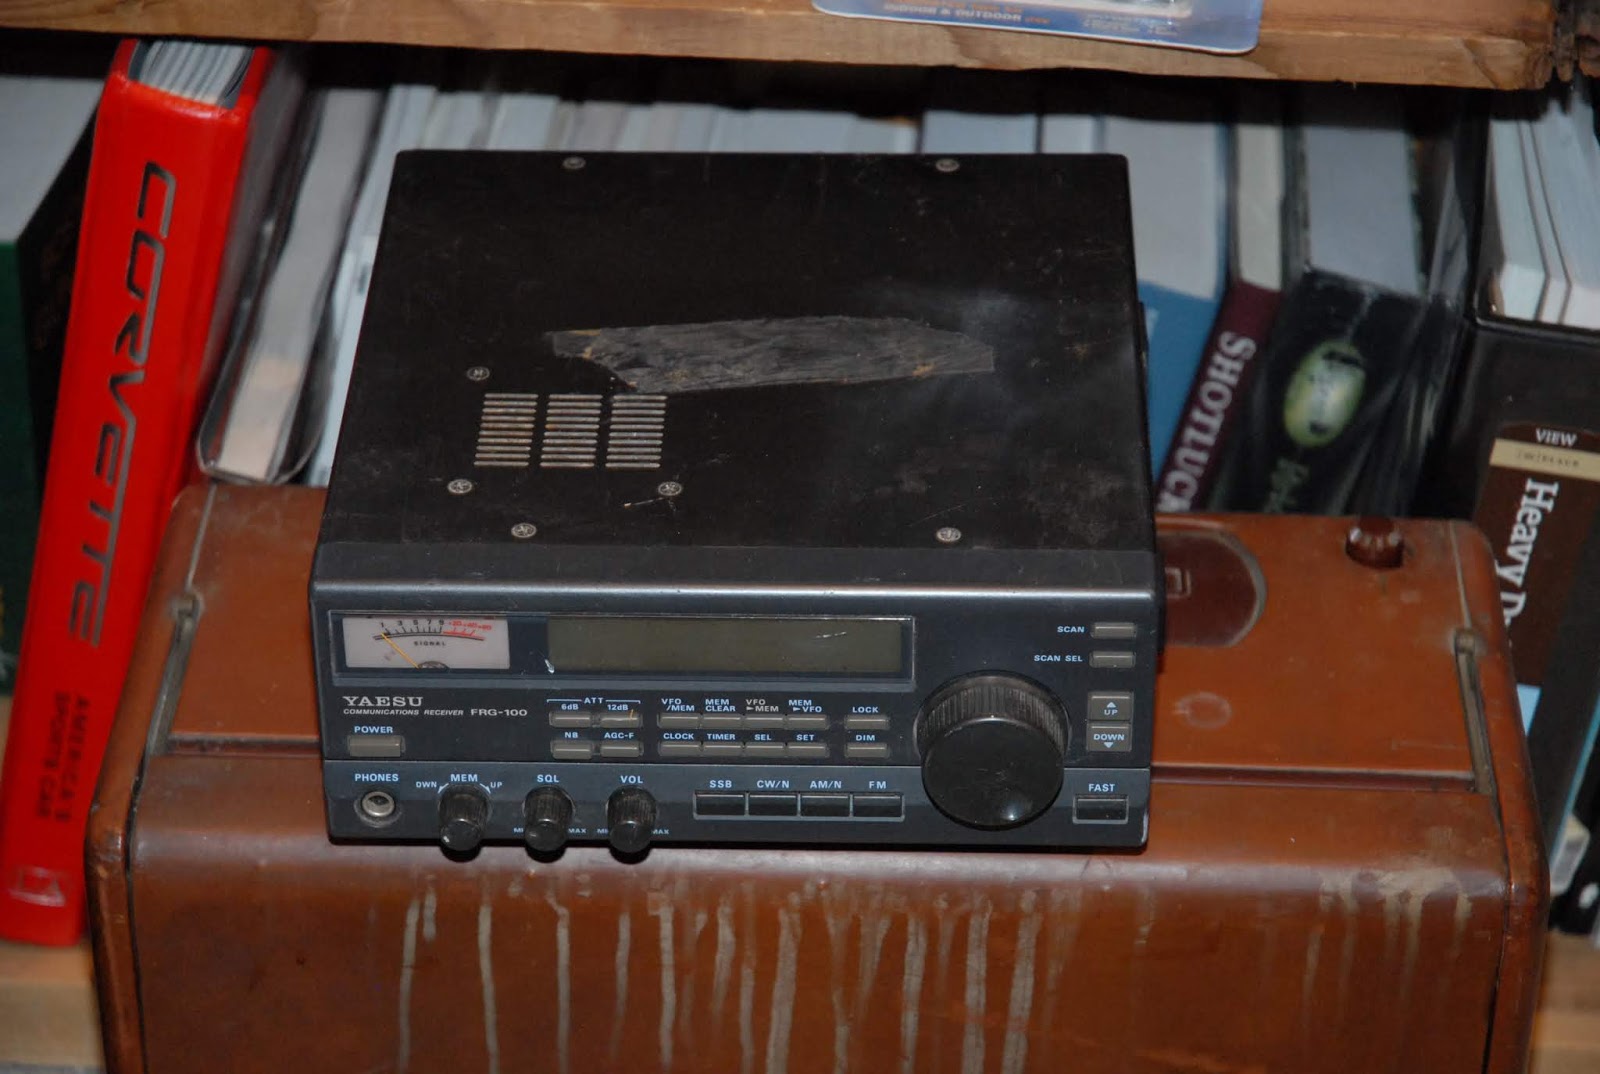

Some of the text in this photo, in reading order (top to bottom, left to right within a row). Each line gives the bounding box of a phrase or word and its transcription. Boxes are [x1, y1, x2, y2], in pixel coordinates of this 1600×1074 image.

[69, 161, 177, 648] CORVETTE
[1535, 428, 1578, 447] VIEW
[1494, 477, 1559, 588] Heavy
[342, 696, 423, 707] YAESU
[561, 703, 579, 711] 6dB
[607, 703, 629, 711] 12dB
[470, 708, 528, 717] FRG-100
[354, 726, 393, 734] POWER
[707, 733, 736, 741] TIMER
[354, 774, 399, 782] PHONES
[450, 774, 478, 782] MEM
[537, 774, 559, 783] SQL
[620, 775, 644, 784] VOL
[490, 781, 503, 789] UP
[709, 780, 732, 788] SSB
[756, 780, 790, 789] CW/N
[809, 780, 842, 789] AM/N
[869, 781, 887, 789] FM
[1088, 784, 1115, 792] FAST
